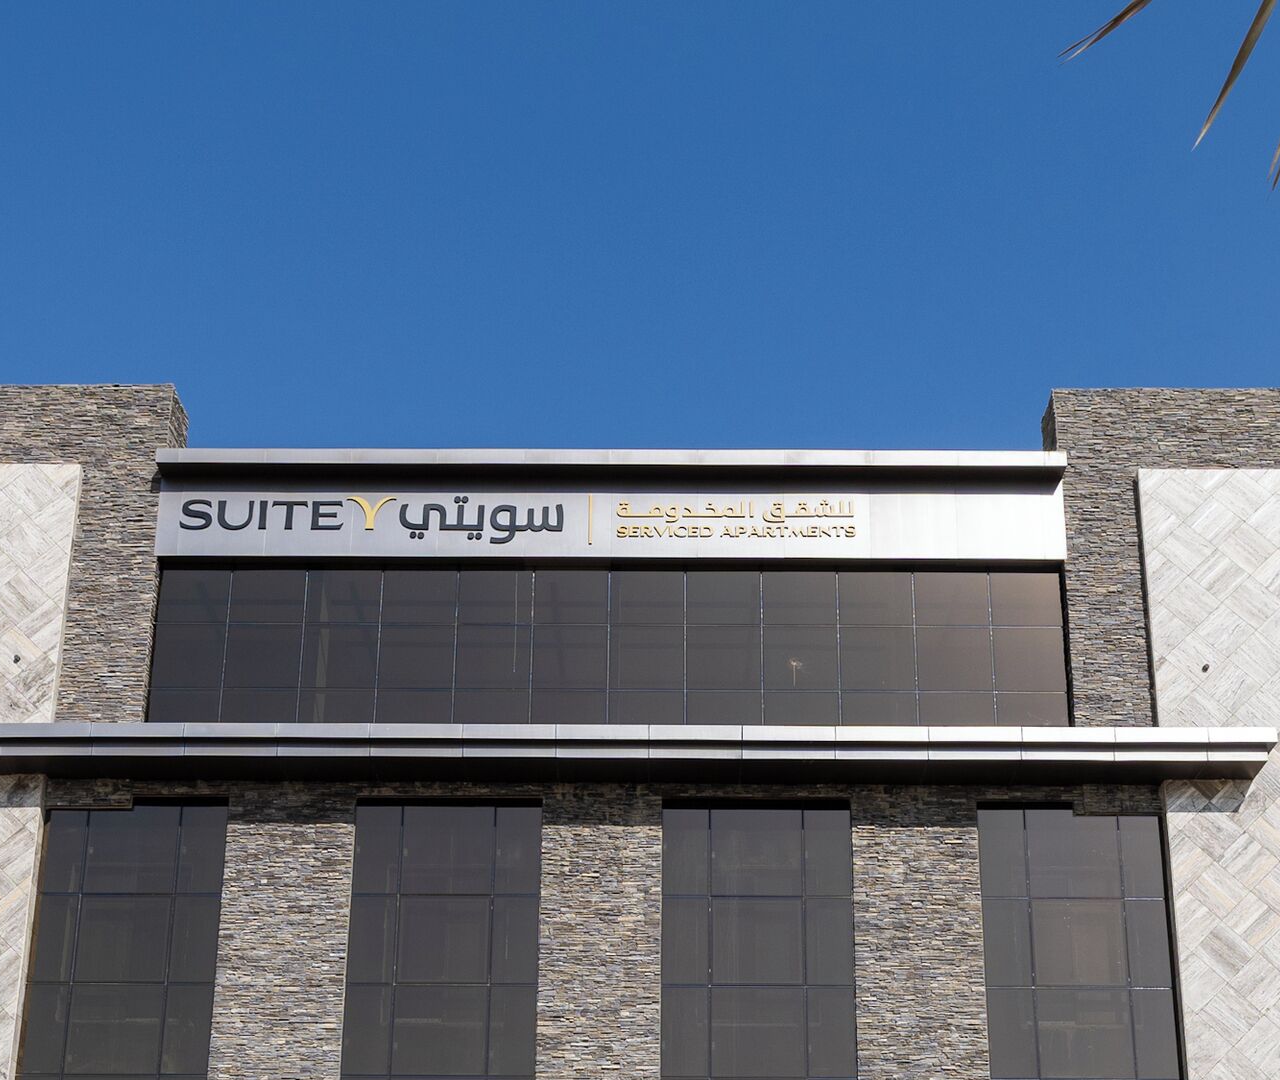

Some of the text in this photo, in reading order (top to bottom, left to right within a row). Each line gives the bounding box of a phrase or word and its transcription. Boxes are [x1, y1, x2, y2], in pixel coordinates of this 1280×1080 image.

[178, 495, 397, 531] SUITEY
[399, 495, 564, 545] سويتي
[616, 500, 754, 524] المخدومة
[616, 525, 857, 539] SERVICED APARTMENTS
